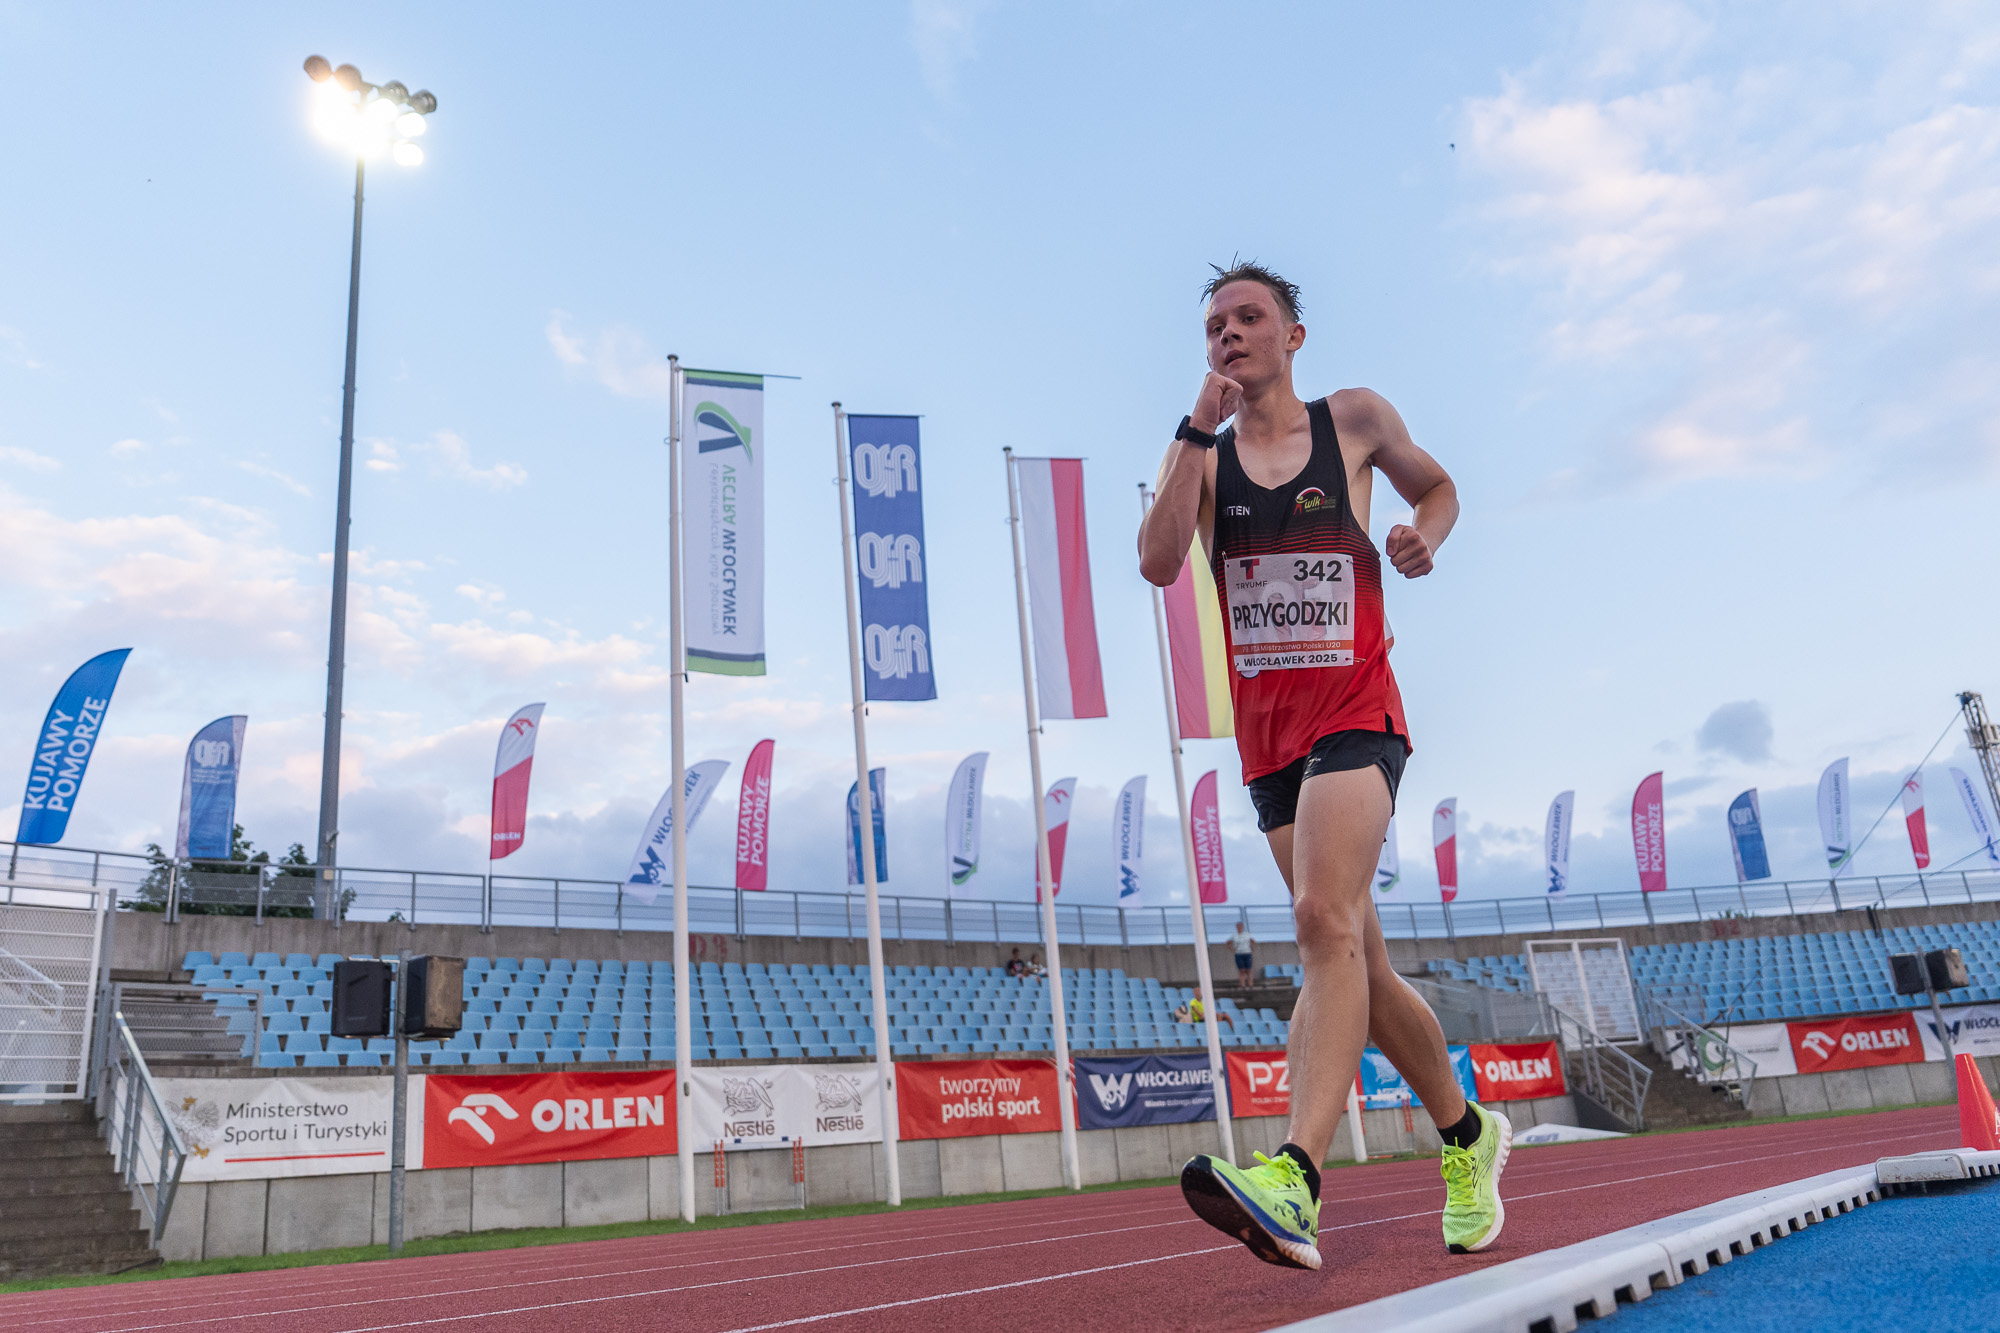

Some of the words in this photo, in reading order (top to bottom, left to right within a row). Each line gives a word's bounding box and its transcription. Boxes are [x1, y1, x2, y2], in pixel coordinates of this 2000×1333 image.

[1293, 559, 1342, 582] 342
[1236, 581, 1268, 590] TRYUMF
[1232, 601, 1348, 630] PRZYGODZKI
[1244, 655, 1305, 667] WŁOCŁAWEK
[1308, 653, 1338, 664] 2025
[1261, 643, 1301, 652] Mistrzostwa
[1303, 642, 1324, 650] Polski
[1326, 641, 1341, 649] U20
[24, 708, 74, 810] KUJAWY
[46, 696, 107, 812] POMORZE
[652, 770, 701, 846] WŁOCWEK
[751, 775, 771, 866] POMORZE
[493, 832, 521, 841] ORLEN
[737, 784, 755, 863] KUJAWY
[1648, 802, 1663, 872] POMORZE
[1194, 816, 1212, 883] KUJAWY
[1206, 805, 1223, 882] POMORZE
[1634, 812, 1650, 872] KUJAWY
[1841, 1028, 1910, 1051] ORLEN
[1485, 1058, 1552, 1082] ORLEN
[940, 1076, 1021, 1096] tworzymy
[226, 1100, 348, 1120] Ministerstwo
[531, 1095, 664, 1132] ORLEN
[942, 1098, 994, 1123] polski
[998, 1097, 1041, 1120] sport
[224, 1122, 287, 1145] Sportu
[293, 1122, 298, 1140] i
[305, 1119, 388, 1142] Turystyki
